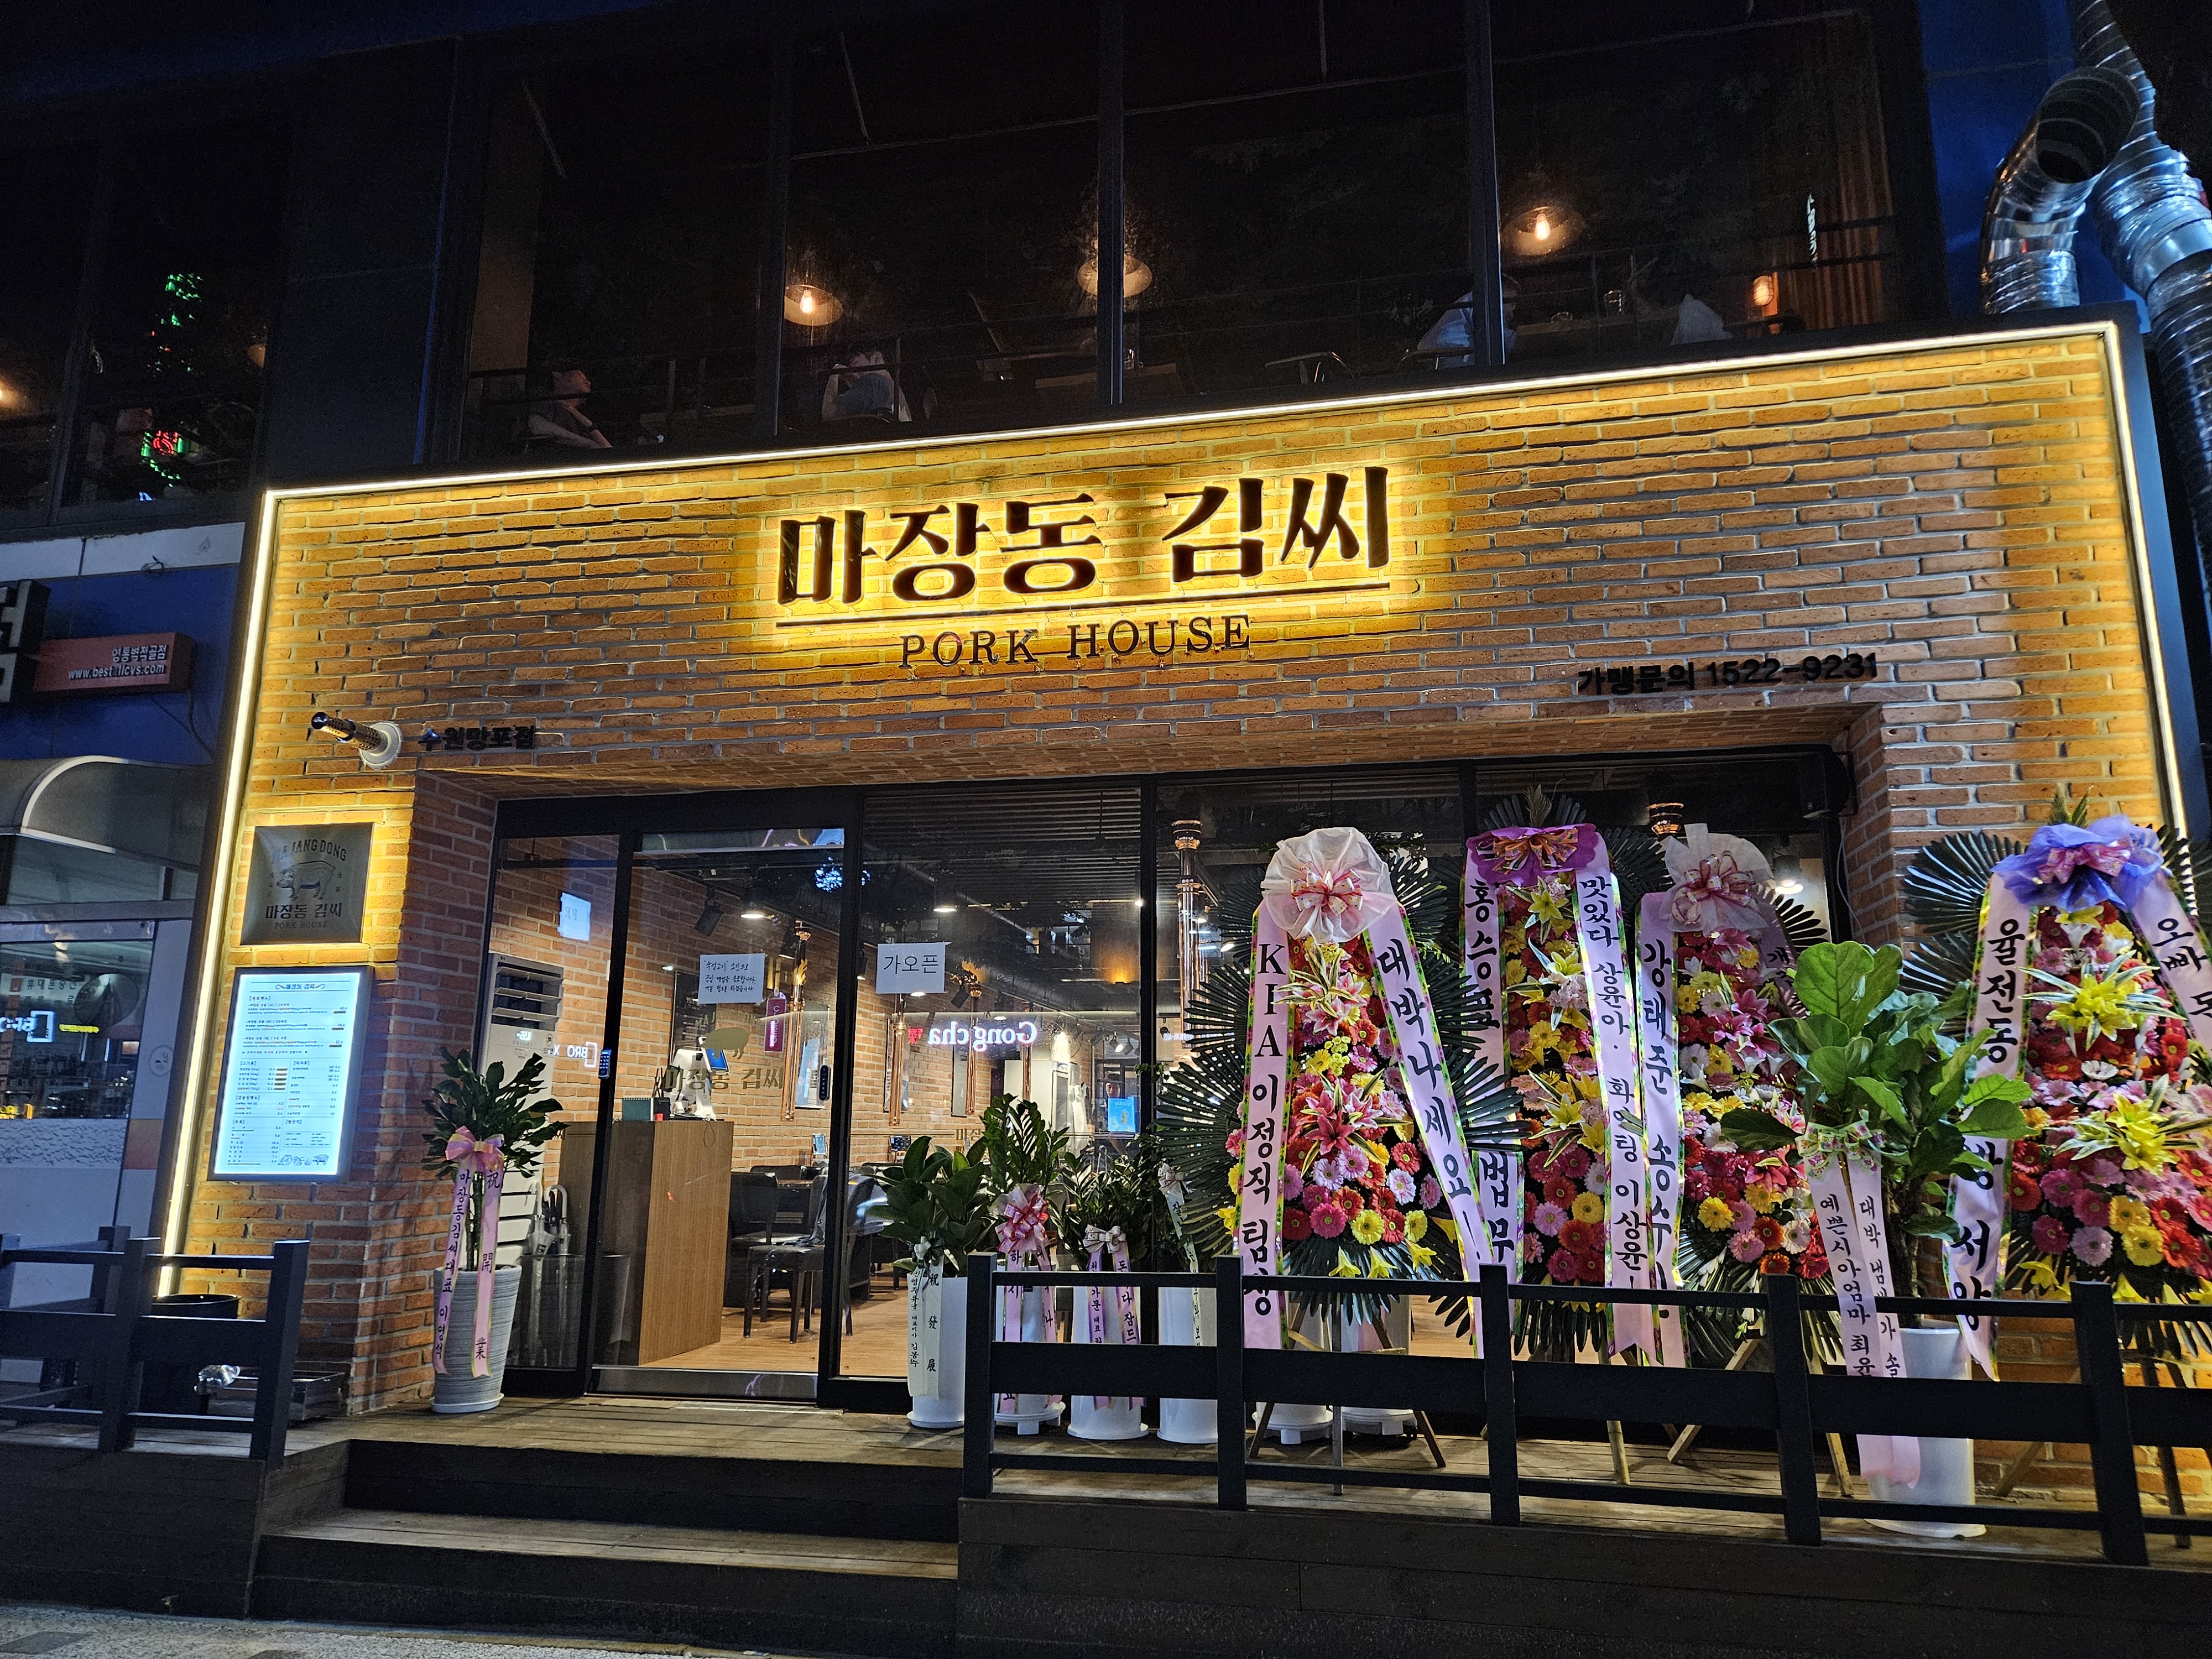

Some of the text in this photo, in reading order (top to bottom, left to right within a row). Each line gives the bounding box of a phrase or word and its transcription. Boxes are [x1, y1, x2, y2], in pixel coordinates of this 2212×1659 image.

[777, 466, 1390, 605] 마장동 김씨
[900, 614, 1251, 669] PORK HOUSE
[1577, 652, 1877, 696] 가맹문의 1522-9231
[266, 902, 342, 919] 마장동 김씨
[1579, 875, 1620, 948] 맛있다
[883, 952, 939, 975] 가오픈
[1980, 918, 2025, 1064] 율전동
[1254, 942, 1287, 1058] KIA
[1644, 938, 1674, 1094] 강태준
[665, 1067, 784, 1091] 마장동 김씨
[1243, 1073, 1278, 1205] 이정직
[1859, 1195, 1881, 1249] 대박
